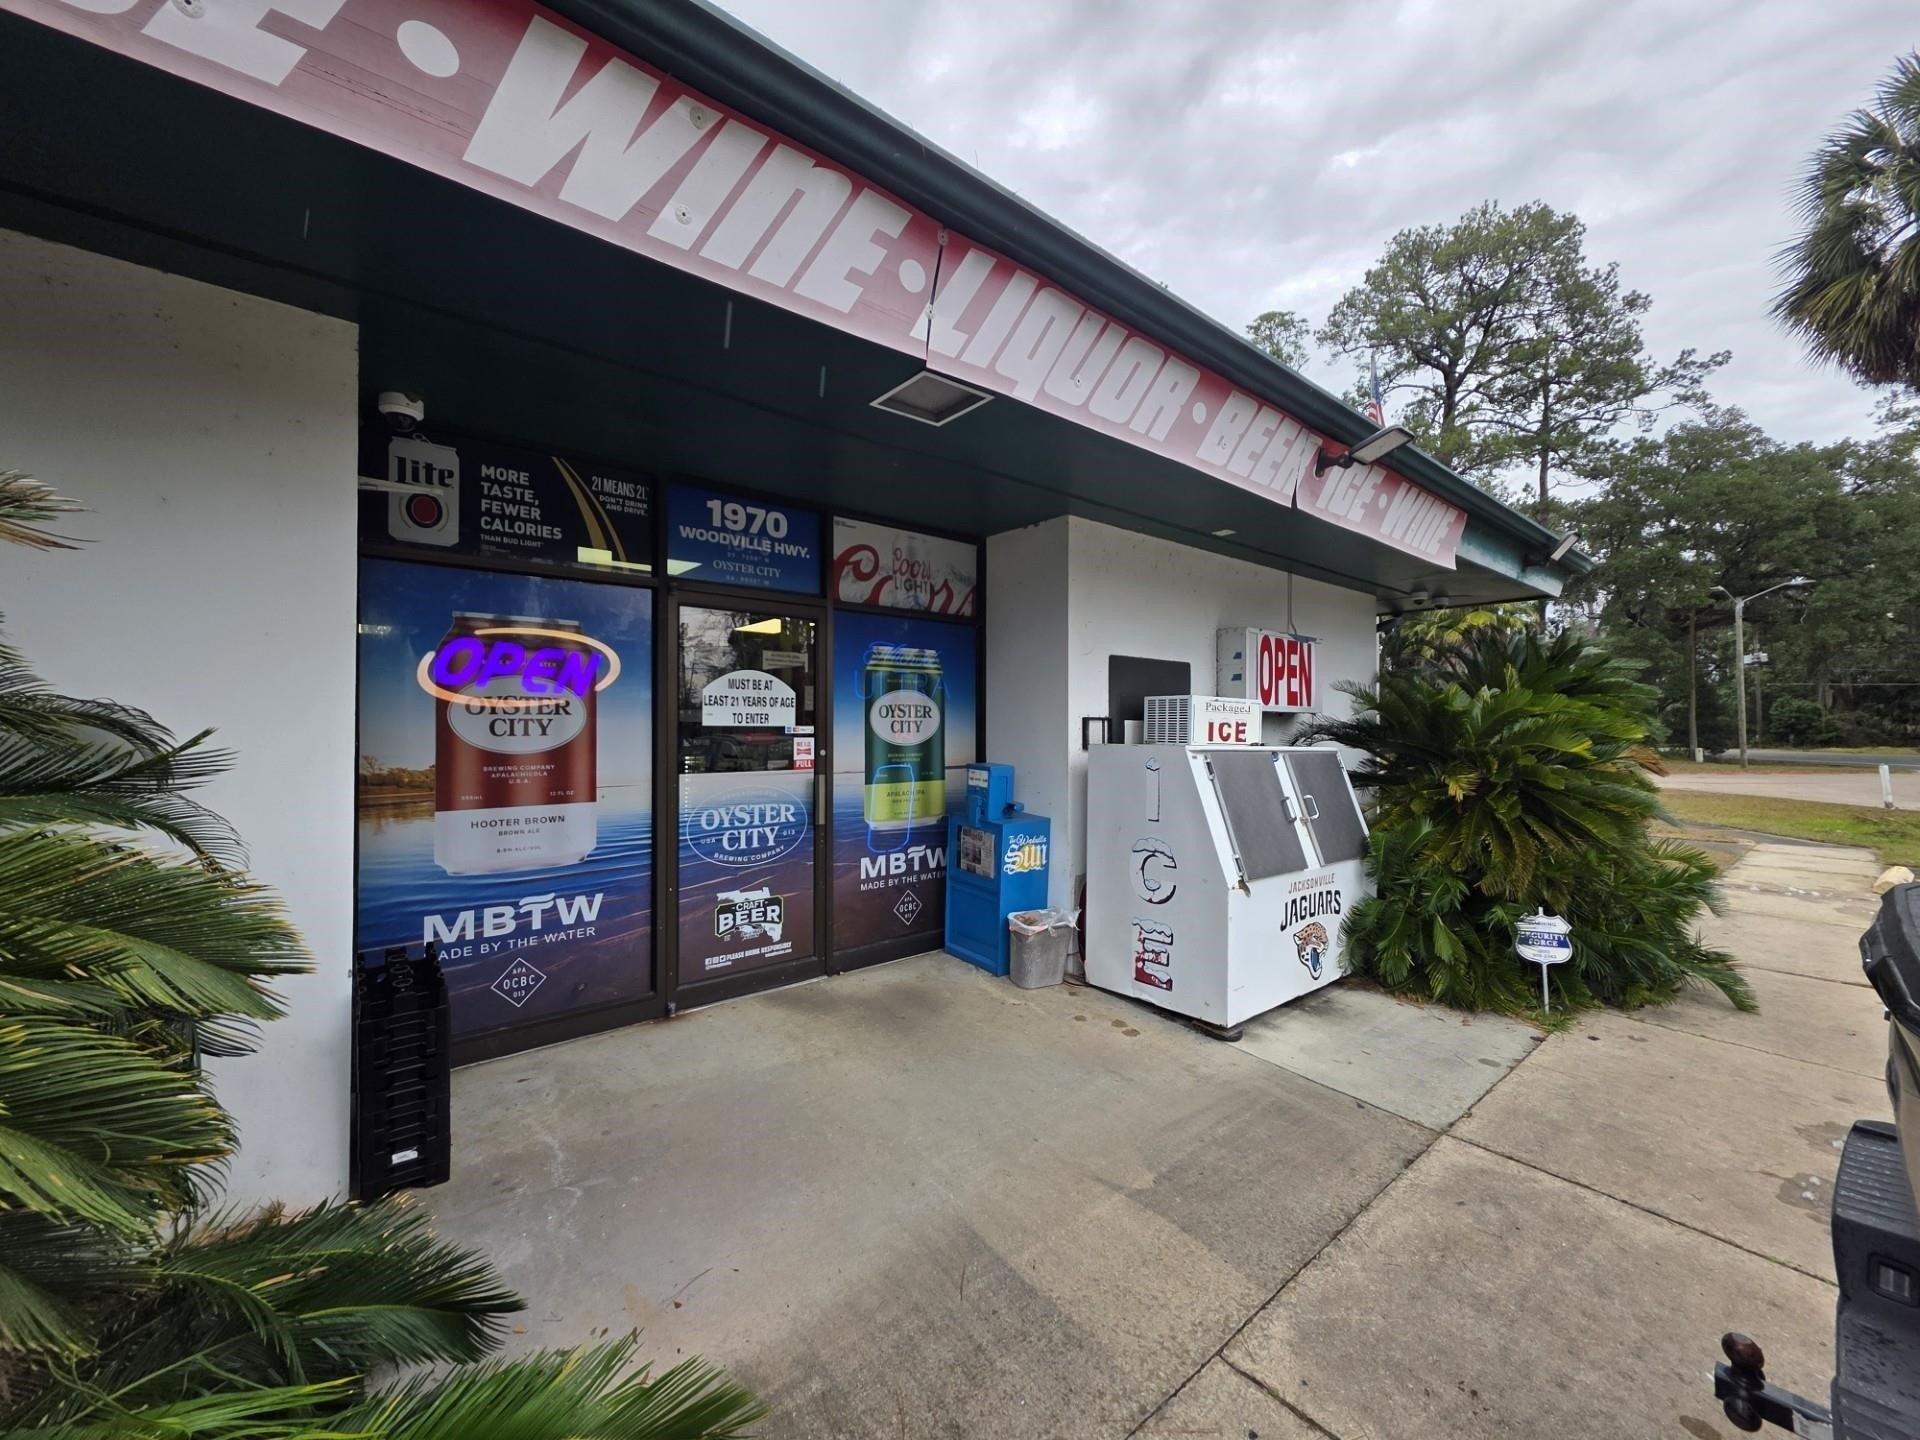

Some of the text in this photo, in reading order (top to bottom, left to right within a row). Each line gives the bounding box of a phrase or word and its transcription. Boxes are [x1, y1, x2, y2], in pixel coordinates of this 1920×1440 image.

[462, 14, 913, 314] WINE
[909, 247, 1200, 442] LIQUOR
[1196, 390, 1323, 496] BEER
[1315, 462, 1388, 524] ICE
[1380, 481, 1460, 557] WINE
[394, 455, 455, 488] lite
[481, 464, 530, 485] MORE
[481, 482, 540, 505] TASTE,
[592, 476, 602, 491] 21
[603, 478, 635, 498] MEANS
[481, 499, 541, 521] FEWER
[600, 494, 648, 510] DON'T DRINK
[606, 503, 622, 512] AND
[481, 517, 563, 540] CALORIES
[707, 499, 788, 539] 1970
[480, 533, 501, 543] THAN
[503, 536, 518, 545] BUD
[679, 525, 772, 552] WOODVILLE
[774, 542, 811, 559] HWY.
[713, 559, 782, 579] OYSTER CITY
[892, 547, 931, 581] Coors
[894, 577, 928, 594] LIGHT
[434, 636, 601, 698] OPEN
[1259, 634, 1312, 707] OPEN
[728, 678, 773, 691] MUST BE AT
[464, 695, 572, 716] OYSTER
[703, 695, 795, 708] LEAST 21 YEARS OF AGE
[879, 703, 932, 719] OYSTER
[489, 718, 553, 737] CITY
[732, 713, 769, 724] TO ENTER
[891, 720, 923, 734] CITY
[1207, 721, 1248, 743] ICE
[519, 764, 555, 772] COMPANY
[796, 760, 812, 768] PULL
[491, 770, 548, 779] APALACHICOLA
[471, 815, 565, 829] HOOTER BROWN
[701, 803, 796, 831] OYSTER
[498, 829, 525, 837] BROWN
[722, 826, 779, 851] CITY
[713, 845, 785, 862] BREWING COMPANY
[1003, 844, 1047, 875] Sun
[860, 881, 886, 892] MADE
[888, 878, 899, 887] BY
[902, 875, 918, 884] THE
[1288, 872, 1336, 895] JACKSONVILLE
[736, 899, 765, 912] CRAFT
[899, 901, 917, 913] OCBC
[1280, 889, 1342, 932] JAGUARS
[423, 892, 604, 947] MBTW
[718, 905, 780, 934] BEER
[436, 927, 596, 961] ADE BY THE WATER
[1528, 938, 1559, 947] FORCE
[726, 951, 745, 961] PLEASE
[511, 966, 527, 975] APA
[503, 974, 536, 990] OCBC
[512, 990, 526, 998] 013
